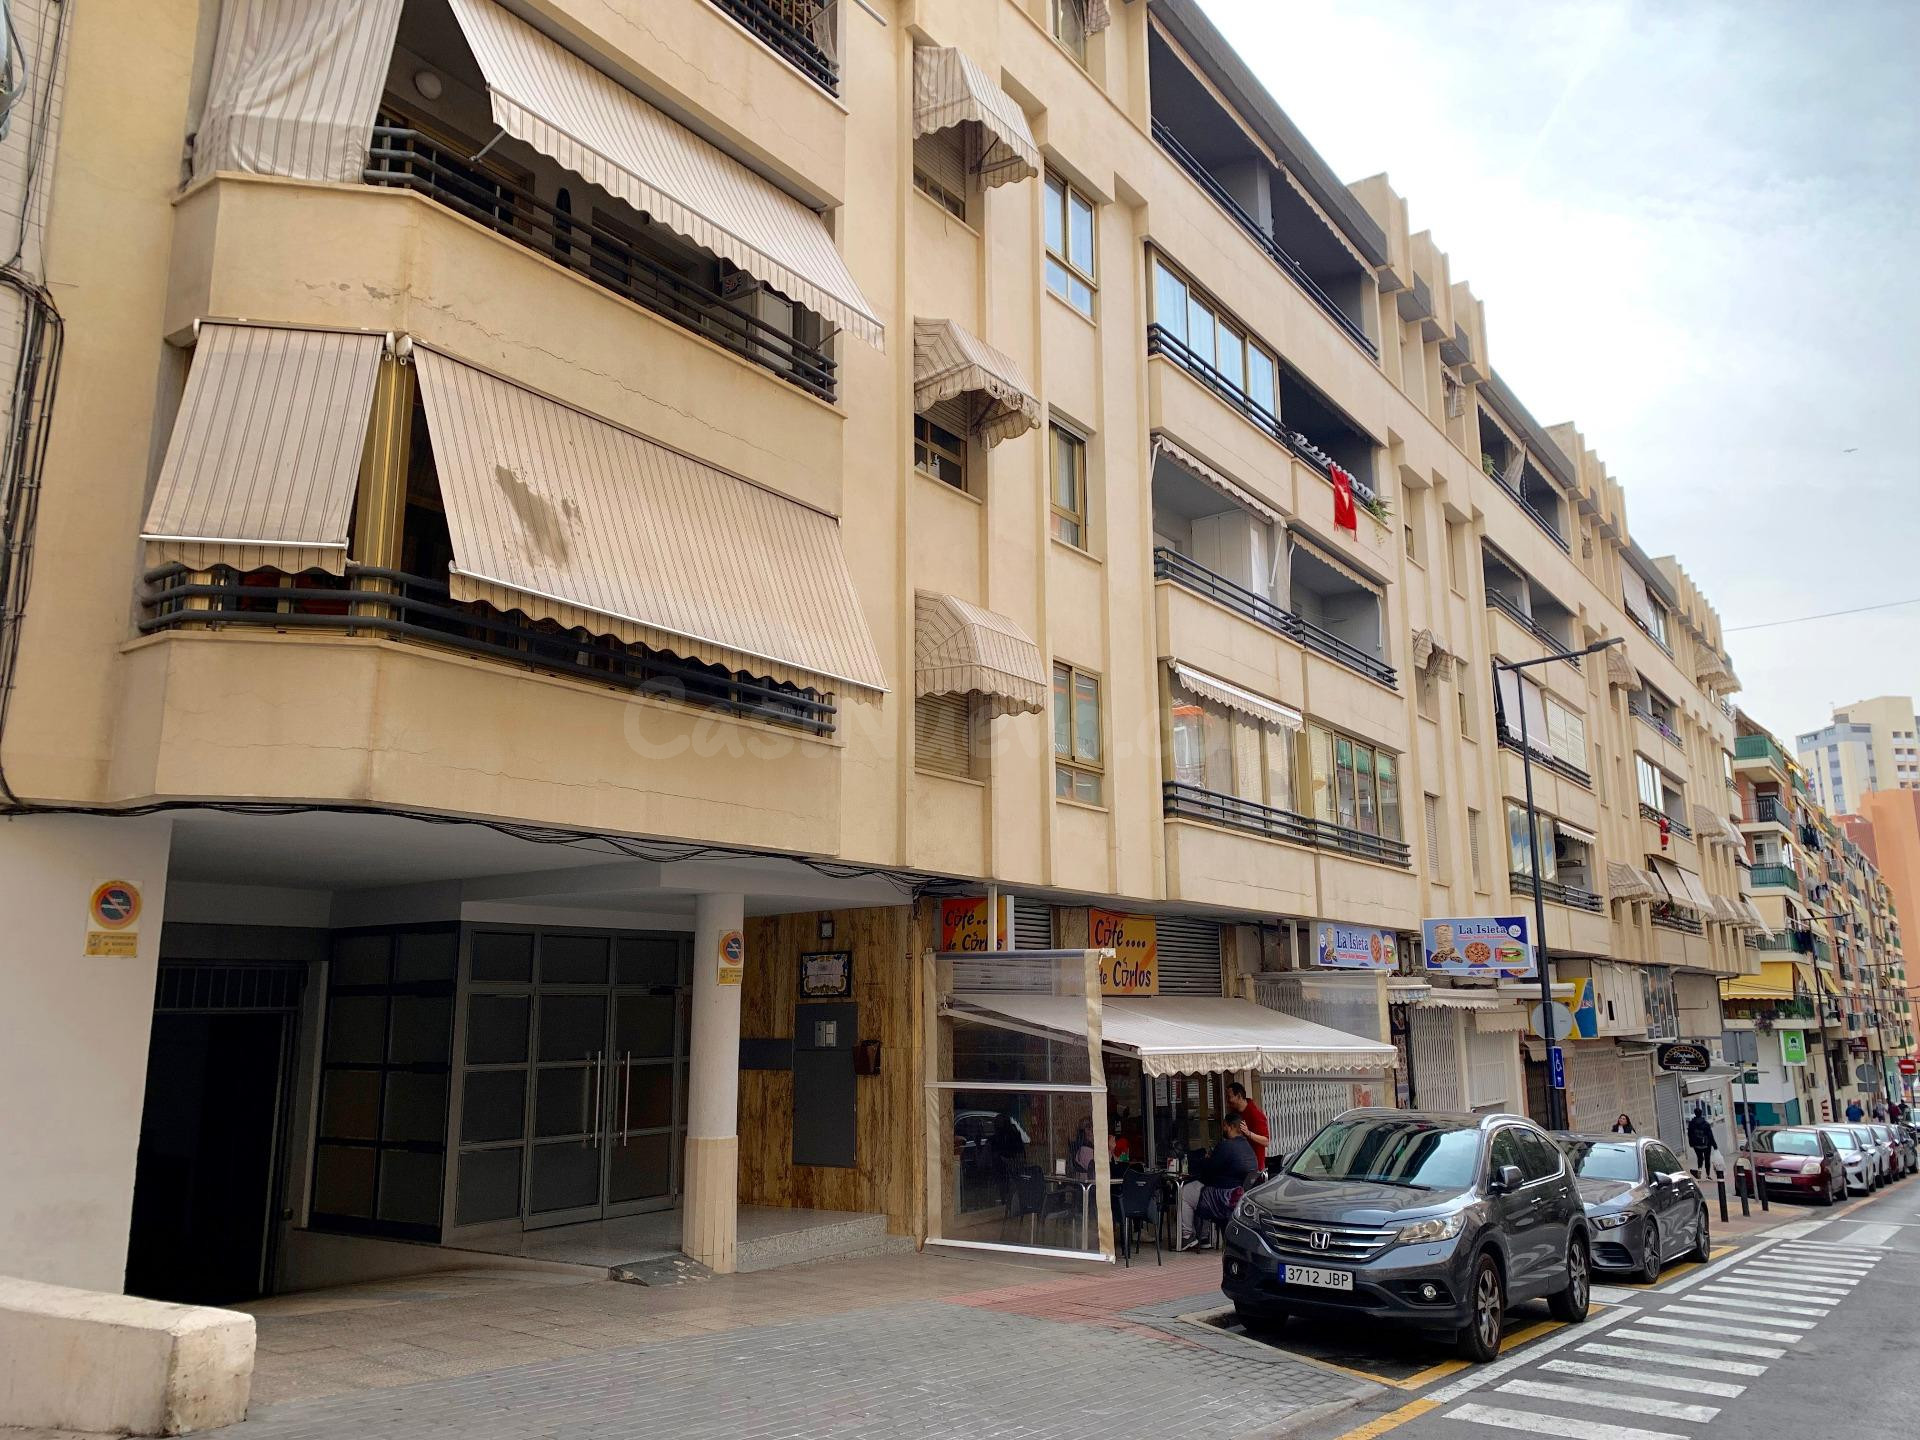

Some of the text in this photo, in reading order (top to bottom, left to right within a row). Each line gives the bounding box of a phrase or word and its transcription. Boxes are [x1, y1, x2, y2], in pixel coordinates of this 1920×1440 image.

[1459, 924, 1473, 935] La
[1477, 924, 1507, 935] Isleta
[946, 931, 1003, 952] de Carls
[1336, 930, 1369, 951] La Isleta
[1113, 957, 1151, 987] Carlos
[1288, 1267, 1349, 1287] 3712 JBP
